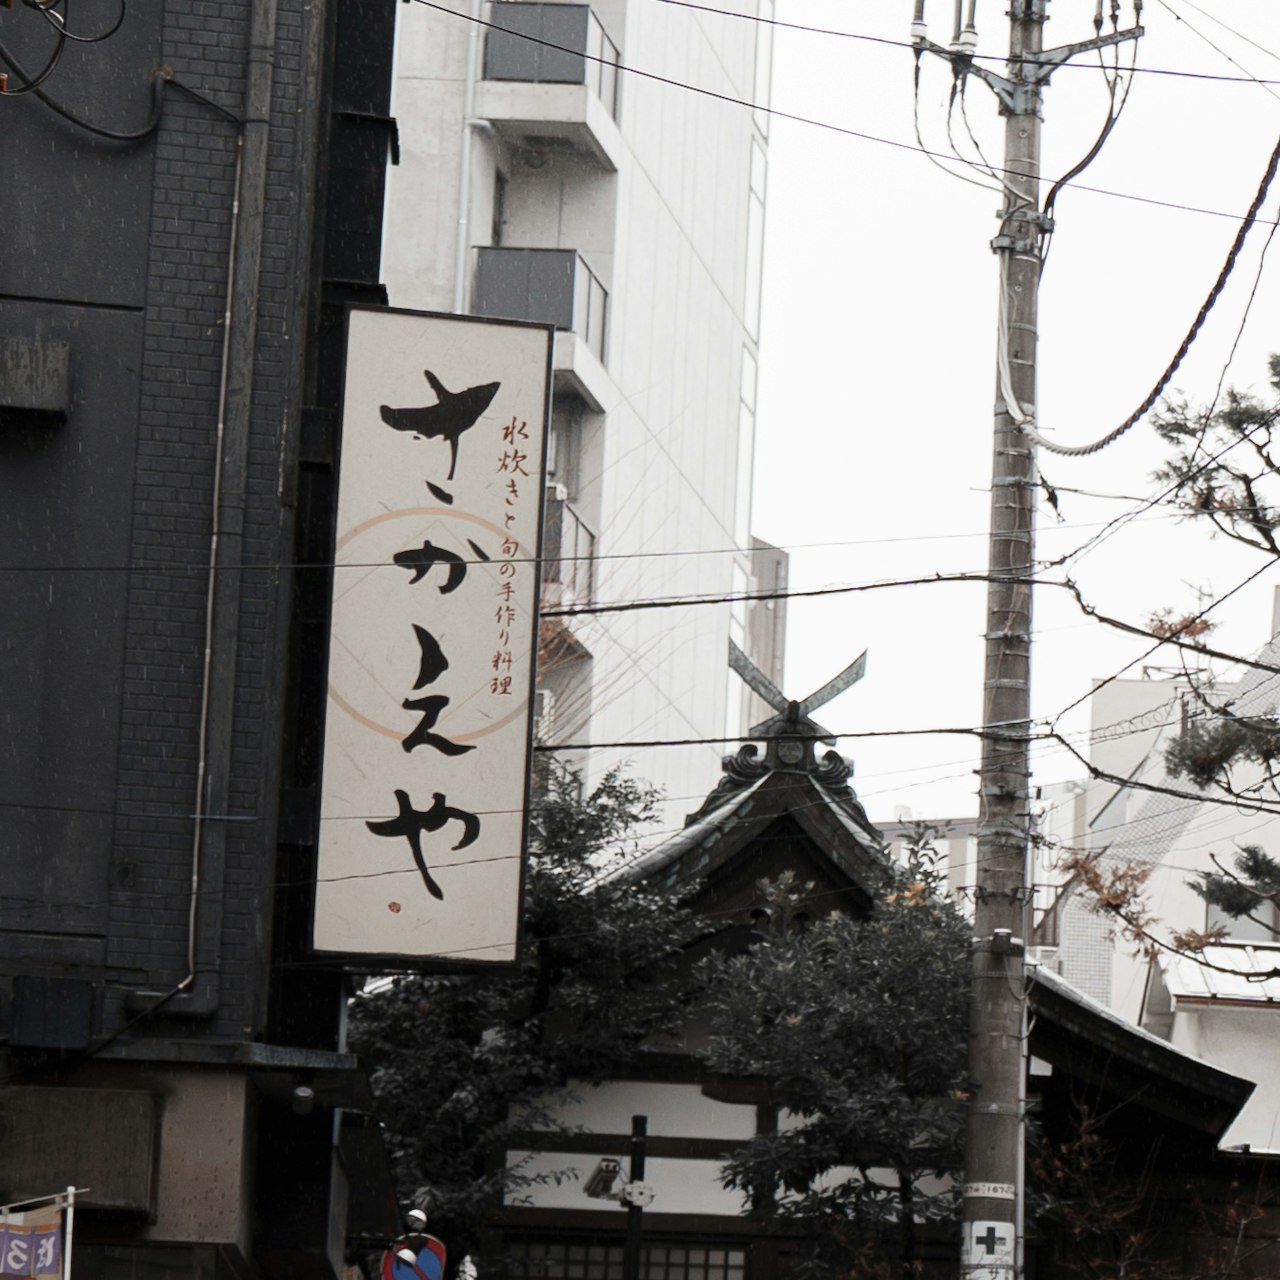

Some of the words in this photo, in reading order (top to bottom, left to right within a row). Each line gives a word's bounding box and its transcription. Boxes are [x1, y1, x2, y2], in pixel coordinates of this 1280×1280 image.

[366, 369, 501, 900] さかえや
[491, 416, 530, 697] 水炊きと旬の手作り料理
